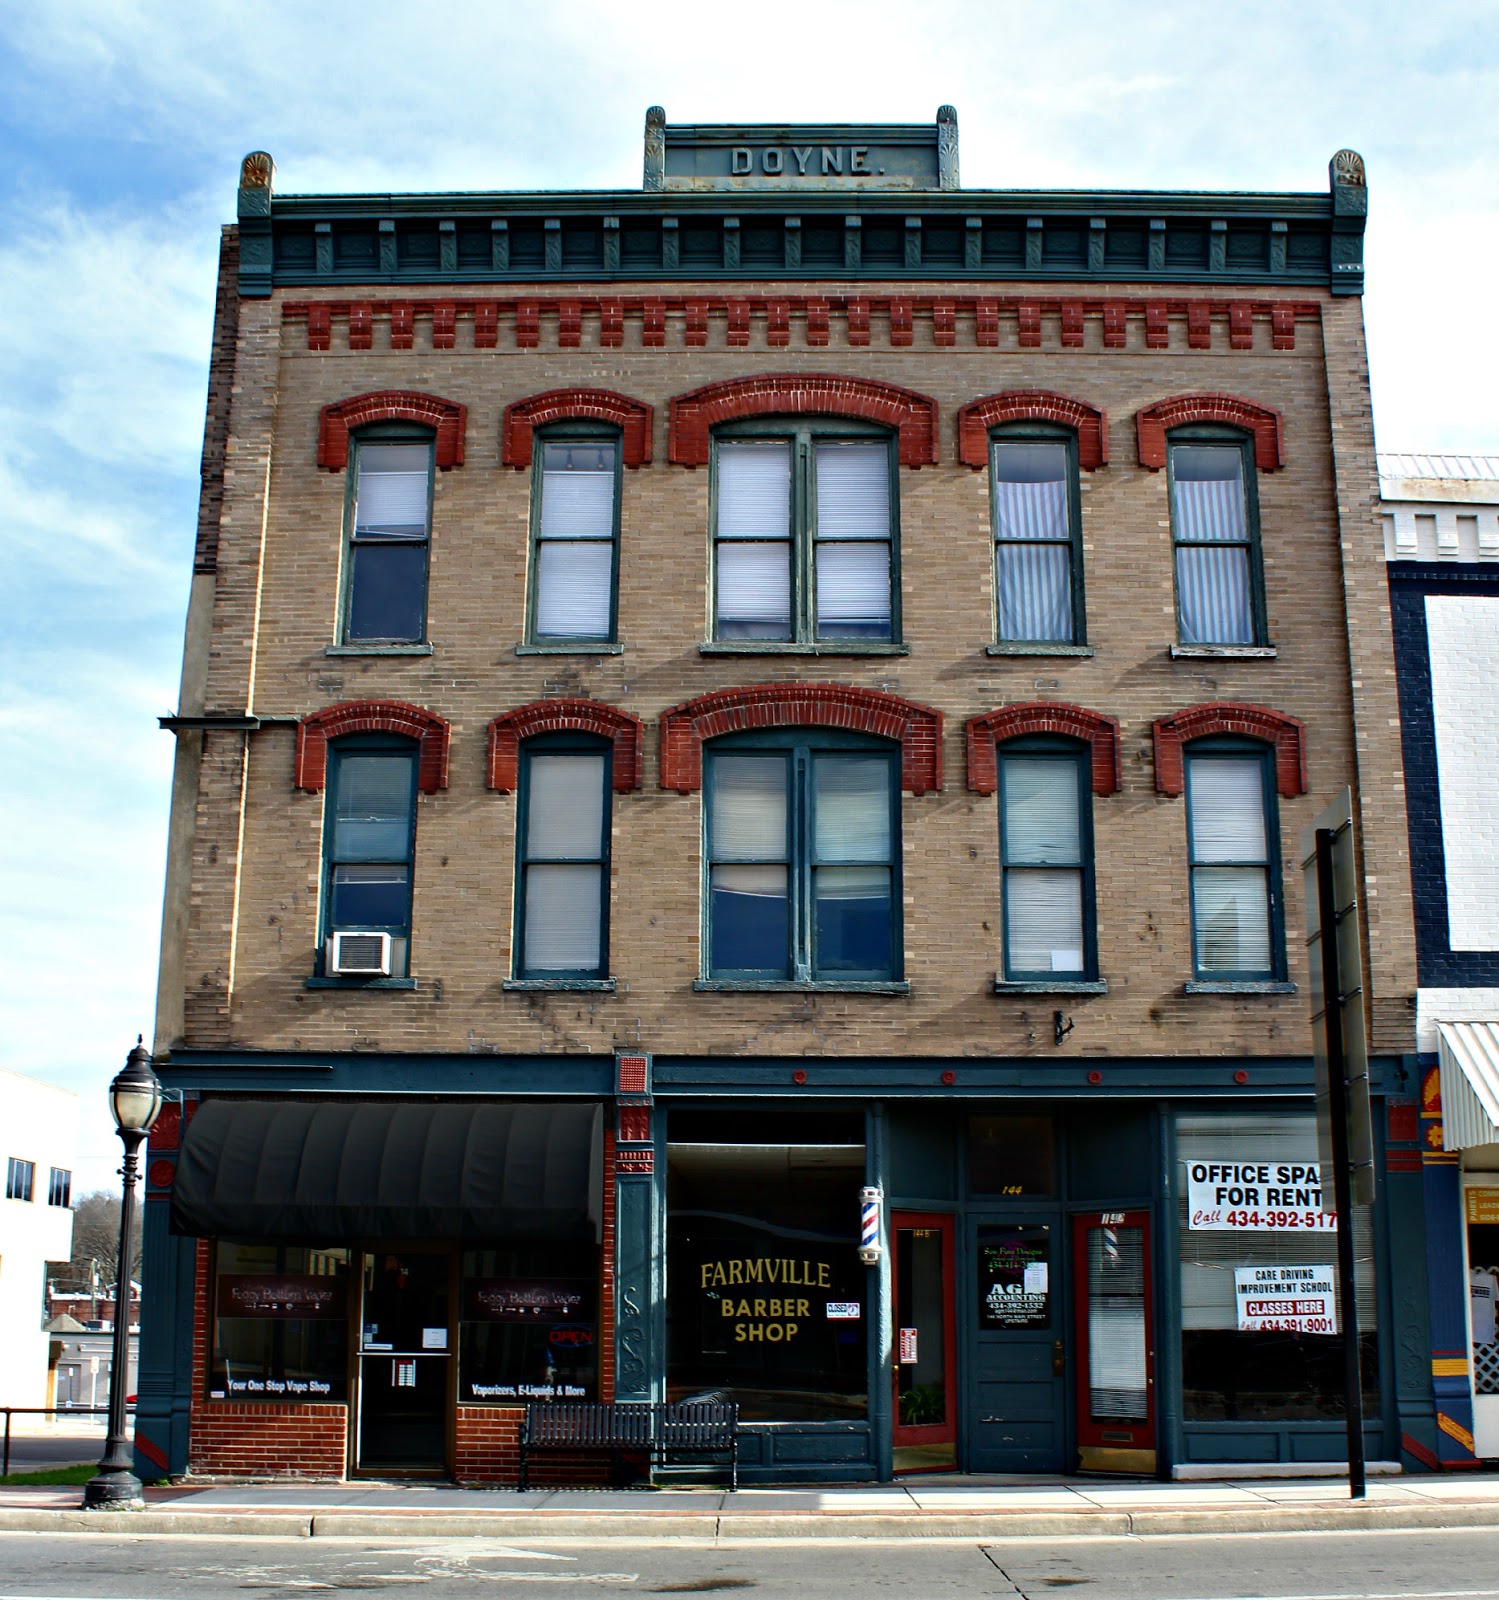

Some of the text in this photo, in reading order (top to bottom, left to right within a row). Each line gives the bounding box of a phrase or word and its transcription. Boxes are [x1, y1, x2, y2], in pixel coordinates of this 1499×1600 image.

[1192, 1164, 1319, 1185] OFFICE SPA
[1002, 1186, 1023, 1195] 144
[1216, 1187, 1322, 1206] FOR RENT
[1193, 1210, 1337, 1228] Call 434-392-517
[701, 1258, 831, 1289] FARMVILLE
[1255, 1269, 1314, 1281] CARE DRIVING
[1238, 1281, 1332, 1294] IMPROVEMENT SCHOOL
[721, 1299, 810, 1317] BARBER
[1248, 1301, 1323, 1315] CLASSES HERE
[549, 1331, 593, 1343] OPEN
[735, 1323, 798, 1341] SHOP
[227, 1379, 331, 1394] Your One Stop Vape Shop
[471, 1384, 586, 1398] Vaporizers, E-Liquids & More
